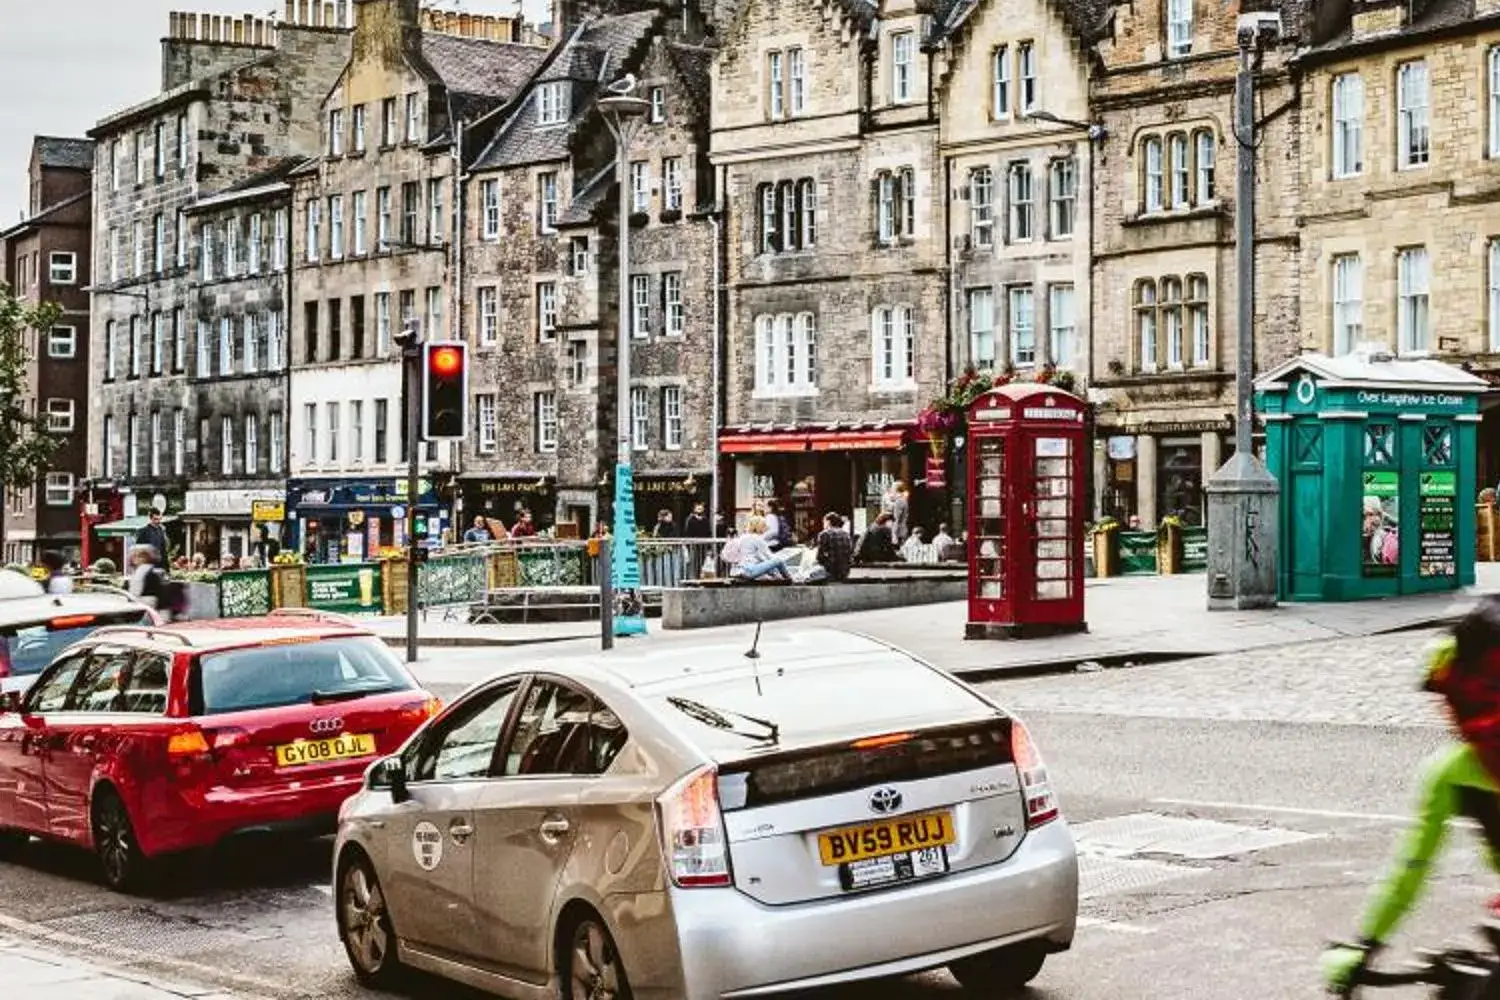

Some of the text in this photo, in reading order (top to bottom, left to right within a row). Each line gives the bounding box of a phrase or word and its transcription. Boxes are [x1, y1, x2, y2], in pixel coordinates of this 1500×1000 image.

[1357, 391, 1378, 403] Over
[1423, 393, 1434, 404] Ice
[1437, 395, 1462, 405] Cream
[481, 483, 495, 492] THE
[285, 738, 367, 762] GY08 OJL
[829, 814, 945, 860] BV59 RUJ
